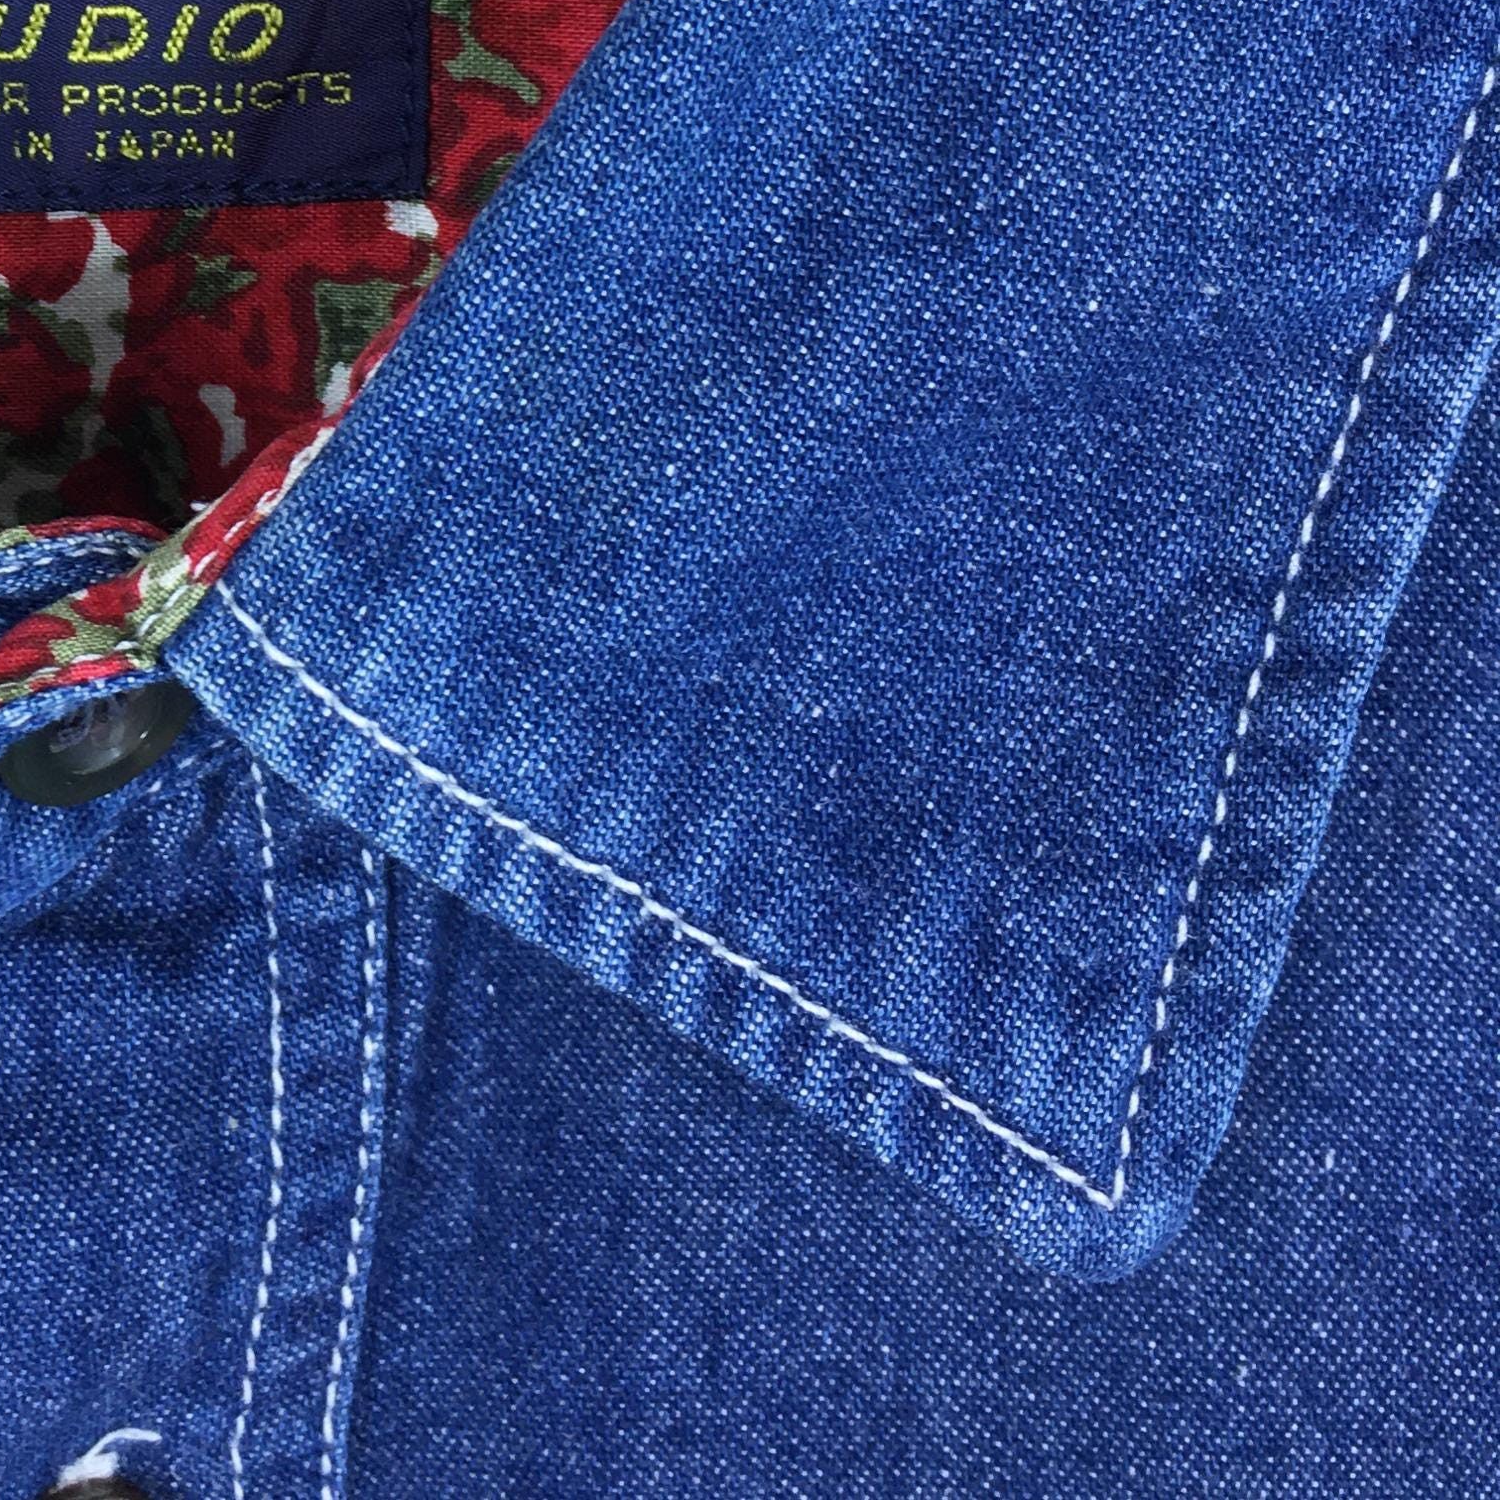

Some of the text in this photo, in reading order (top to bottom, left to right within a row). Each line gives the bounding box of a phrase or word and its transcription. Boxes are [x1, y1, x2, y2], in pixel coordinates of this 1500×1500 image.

[61, 72, 352, 116] PRODUCTS
[13, 128, 54, 163] IN
[86, 128, 235, 163] JAPAN
